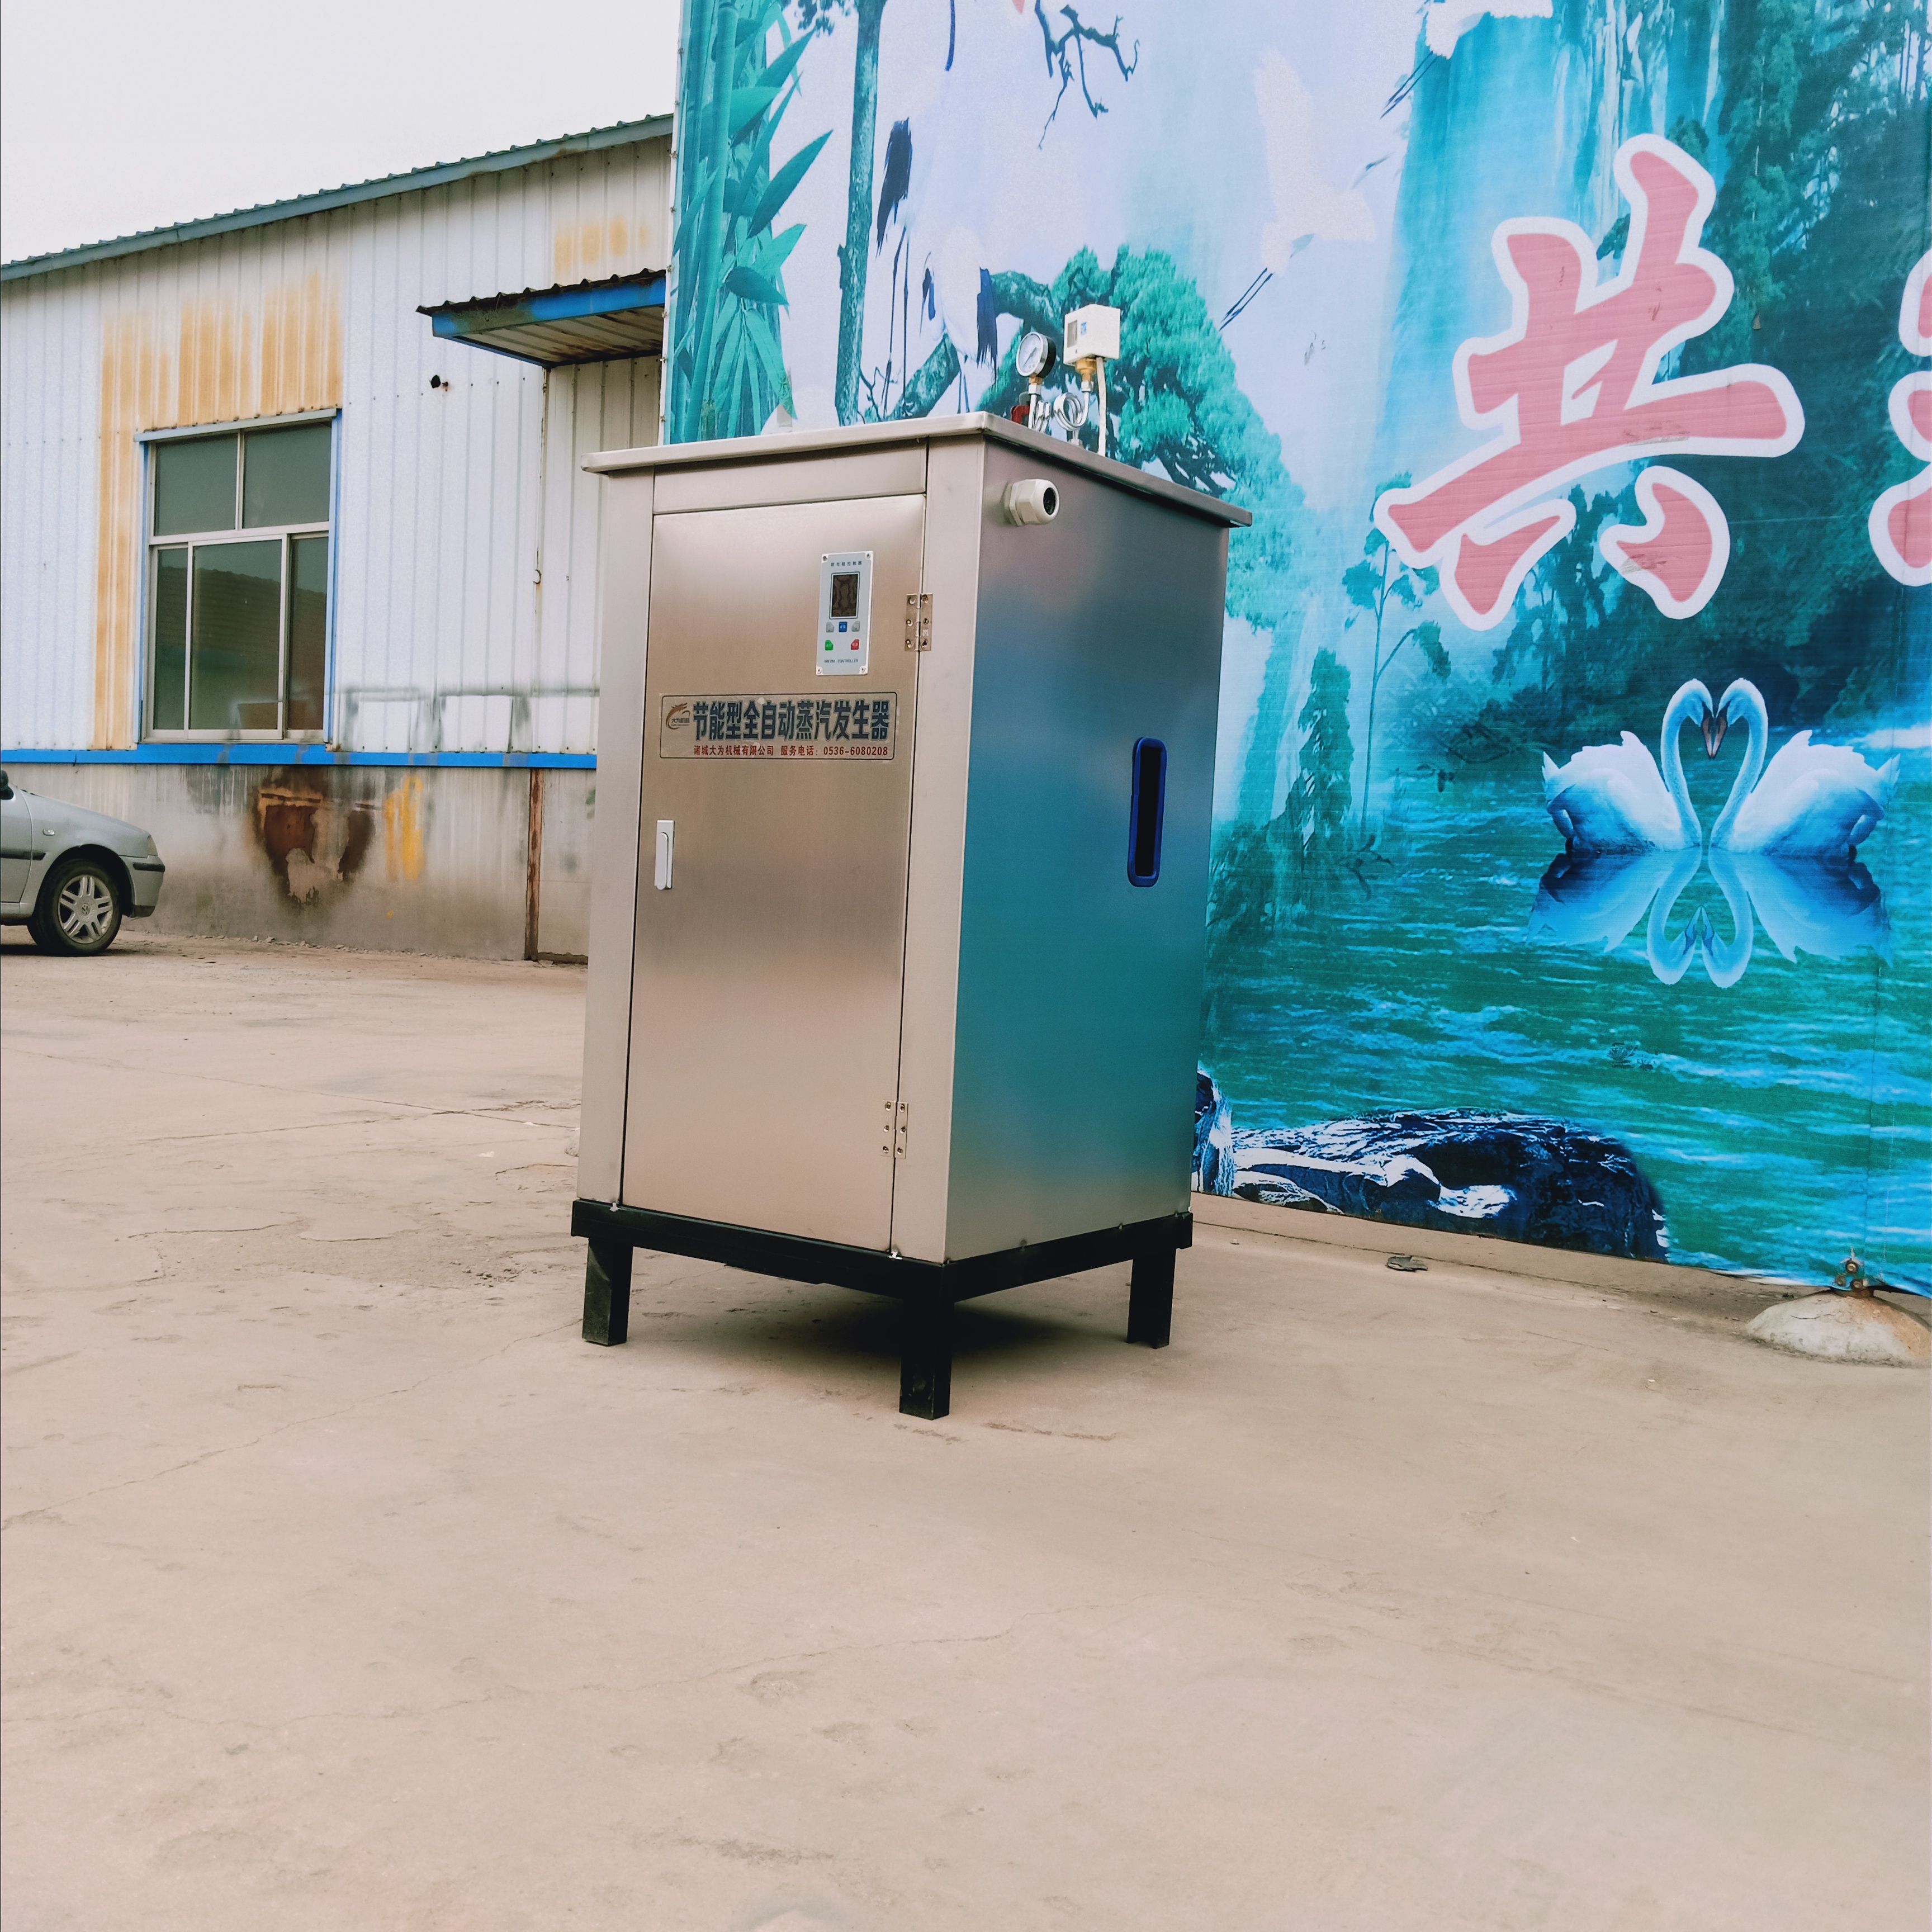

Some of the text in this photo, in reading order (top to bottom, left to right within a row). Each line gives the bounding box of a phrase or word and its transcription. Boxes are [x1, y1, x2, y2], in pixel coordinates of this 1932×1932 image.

[1374, 133, 1932, 631] 共
[693, 699, 889, 741] 节能型全自动蒸汽发生器
[694, 745, 774, 756] 诸城大为机械有限公司
